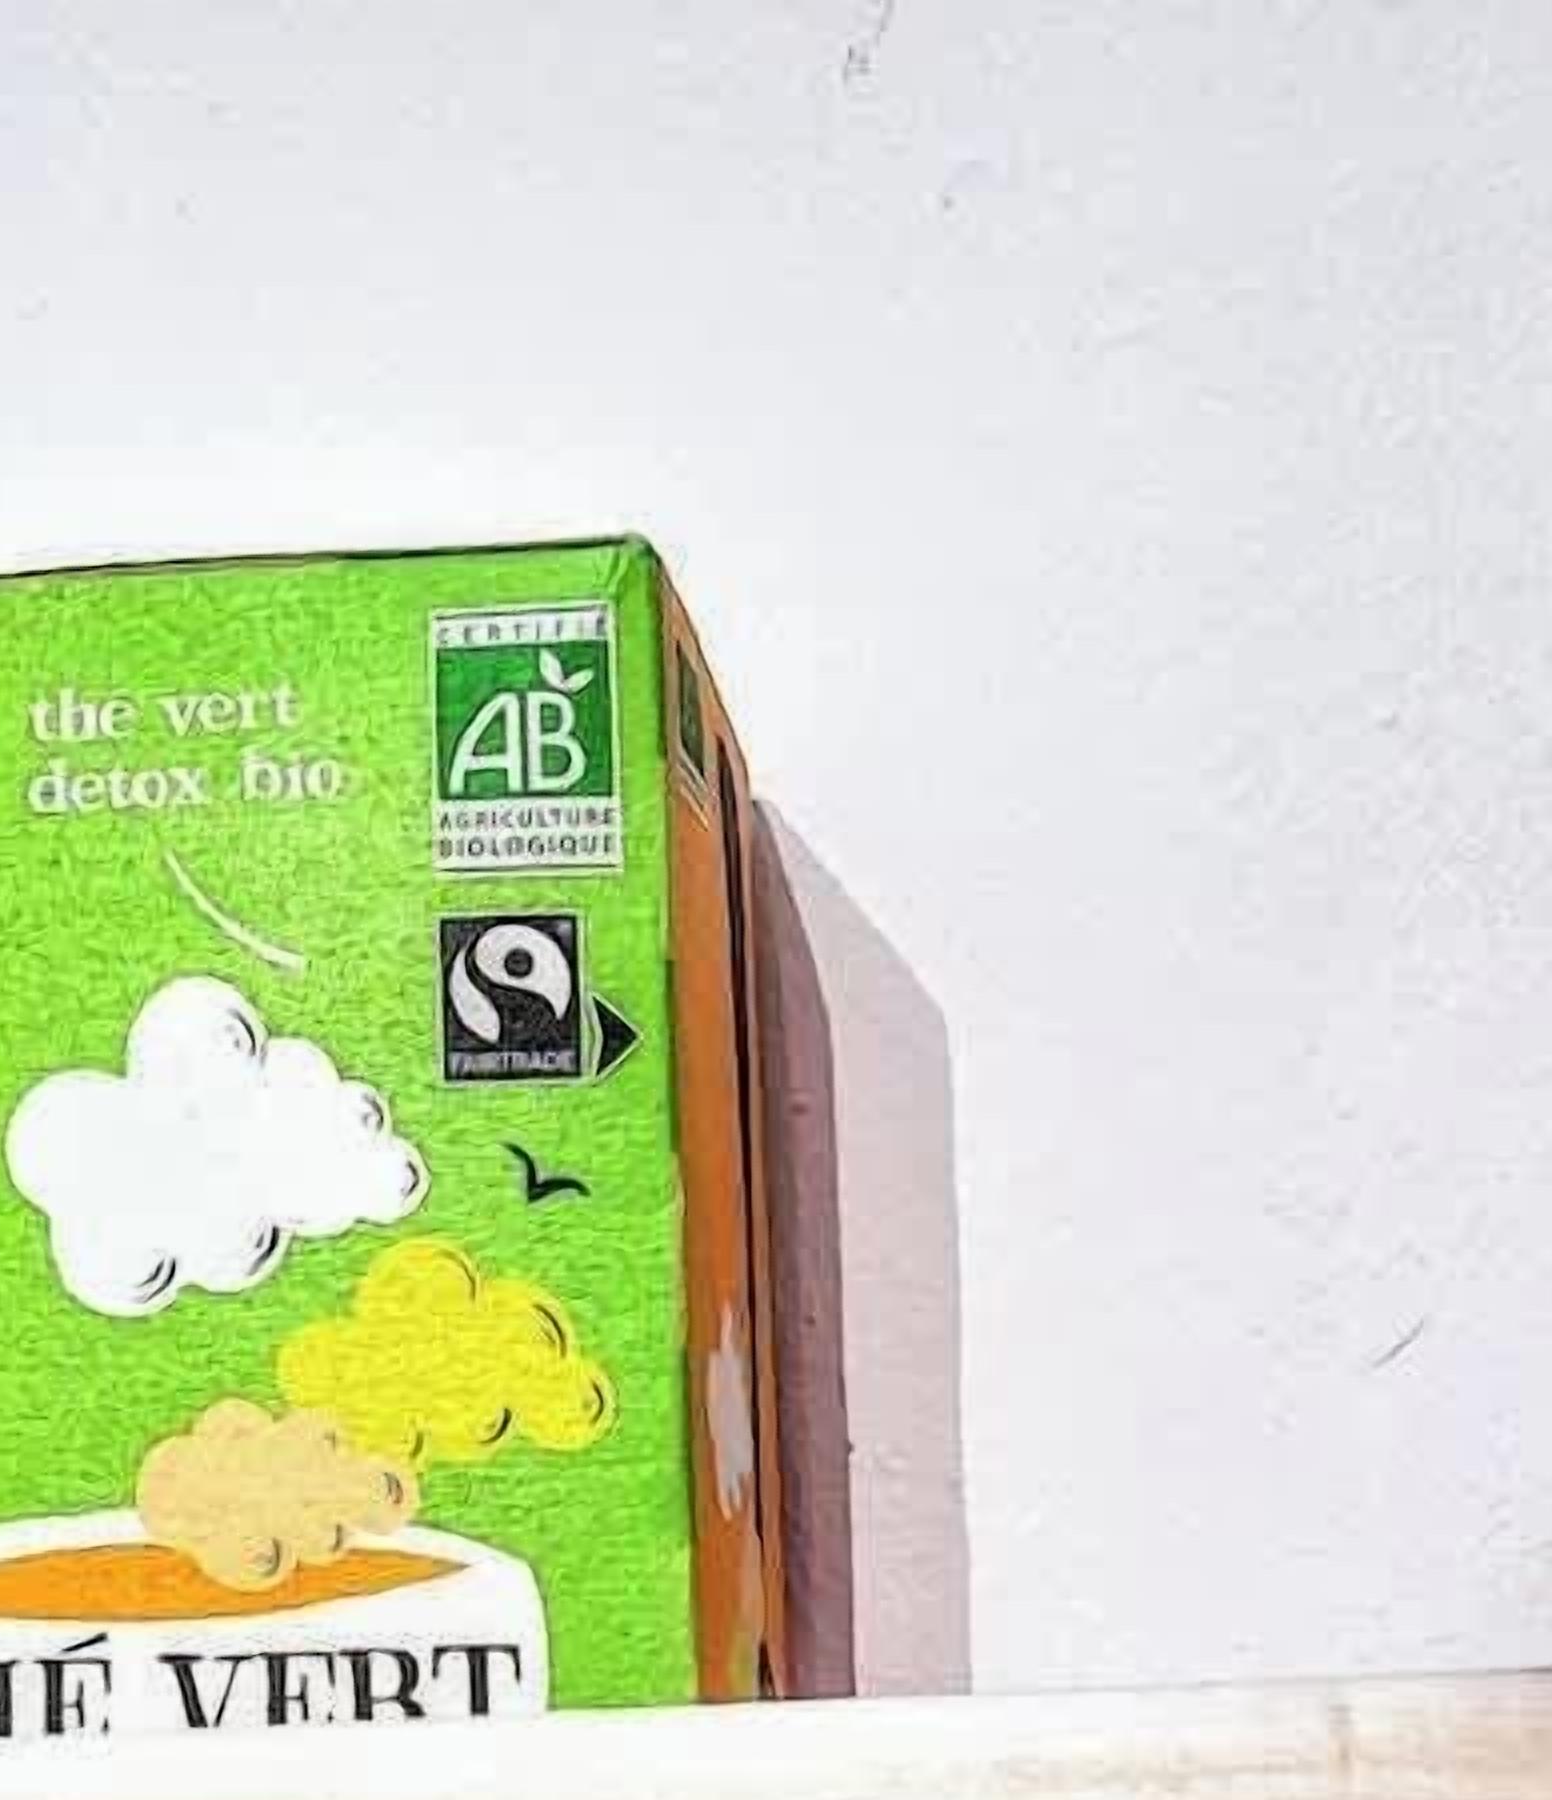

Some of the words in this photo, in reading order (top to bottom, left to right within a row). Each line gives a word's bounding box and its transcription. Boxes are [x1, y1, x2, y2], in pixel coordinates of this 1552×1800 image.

[159, 683, 297, 737] vert
[449, 690, 587, 796] AB
[27, 757, 204, 813] detox
[241, 745, 342, 802] bio
[439, 806, 616, 831] AGRICULTURE
[439, 832, 612, 858] BIOLOGIQUE
[157, 1643, 522, 1729] VERT
